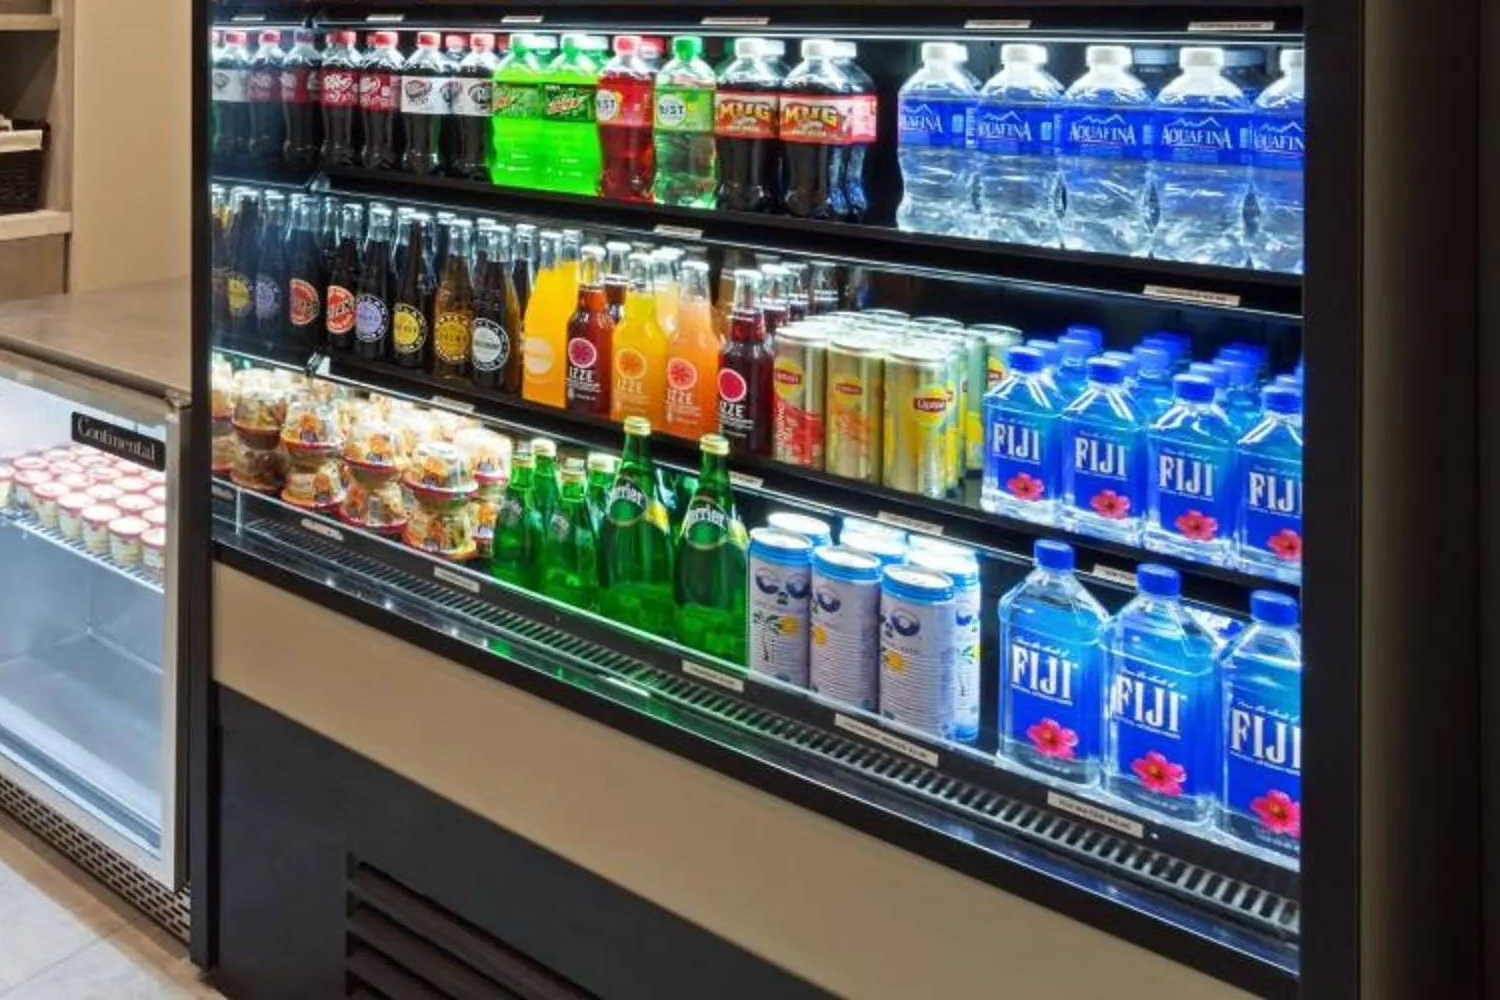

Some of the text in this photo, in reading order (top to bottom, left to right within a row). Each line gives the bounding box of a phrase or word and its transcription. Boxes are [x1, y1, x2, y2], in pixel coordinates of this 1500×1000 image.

[718, 101, 773, 121] MUG
[785, 103, 838, 126] MUG
[1069, 122, 1136, 145] AQUAFINA
[1160, 125, 1233, 149] AQUAFINA
[569, 366, 595, 383] IZZE
[616, 378, 643, 394] IZZE
[666, 389, 693, 406] IZZE
[77, 415, 156, 460] Continental
[993, 423, 1040, 461] FIJI
[1075, 437, 1126, 476] FIJI
[1159, 455, 1213, 497] FIJI
[1011, 643, 1072, 699] FIJI
[1114, 673, 1180, 733] FIJI
[1230, 708, 1302, 769] FIJI
